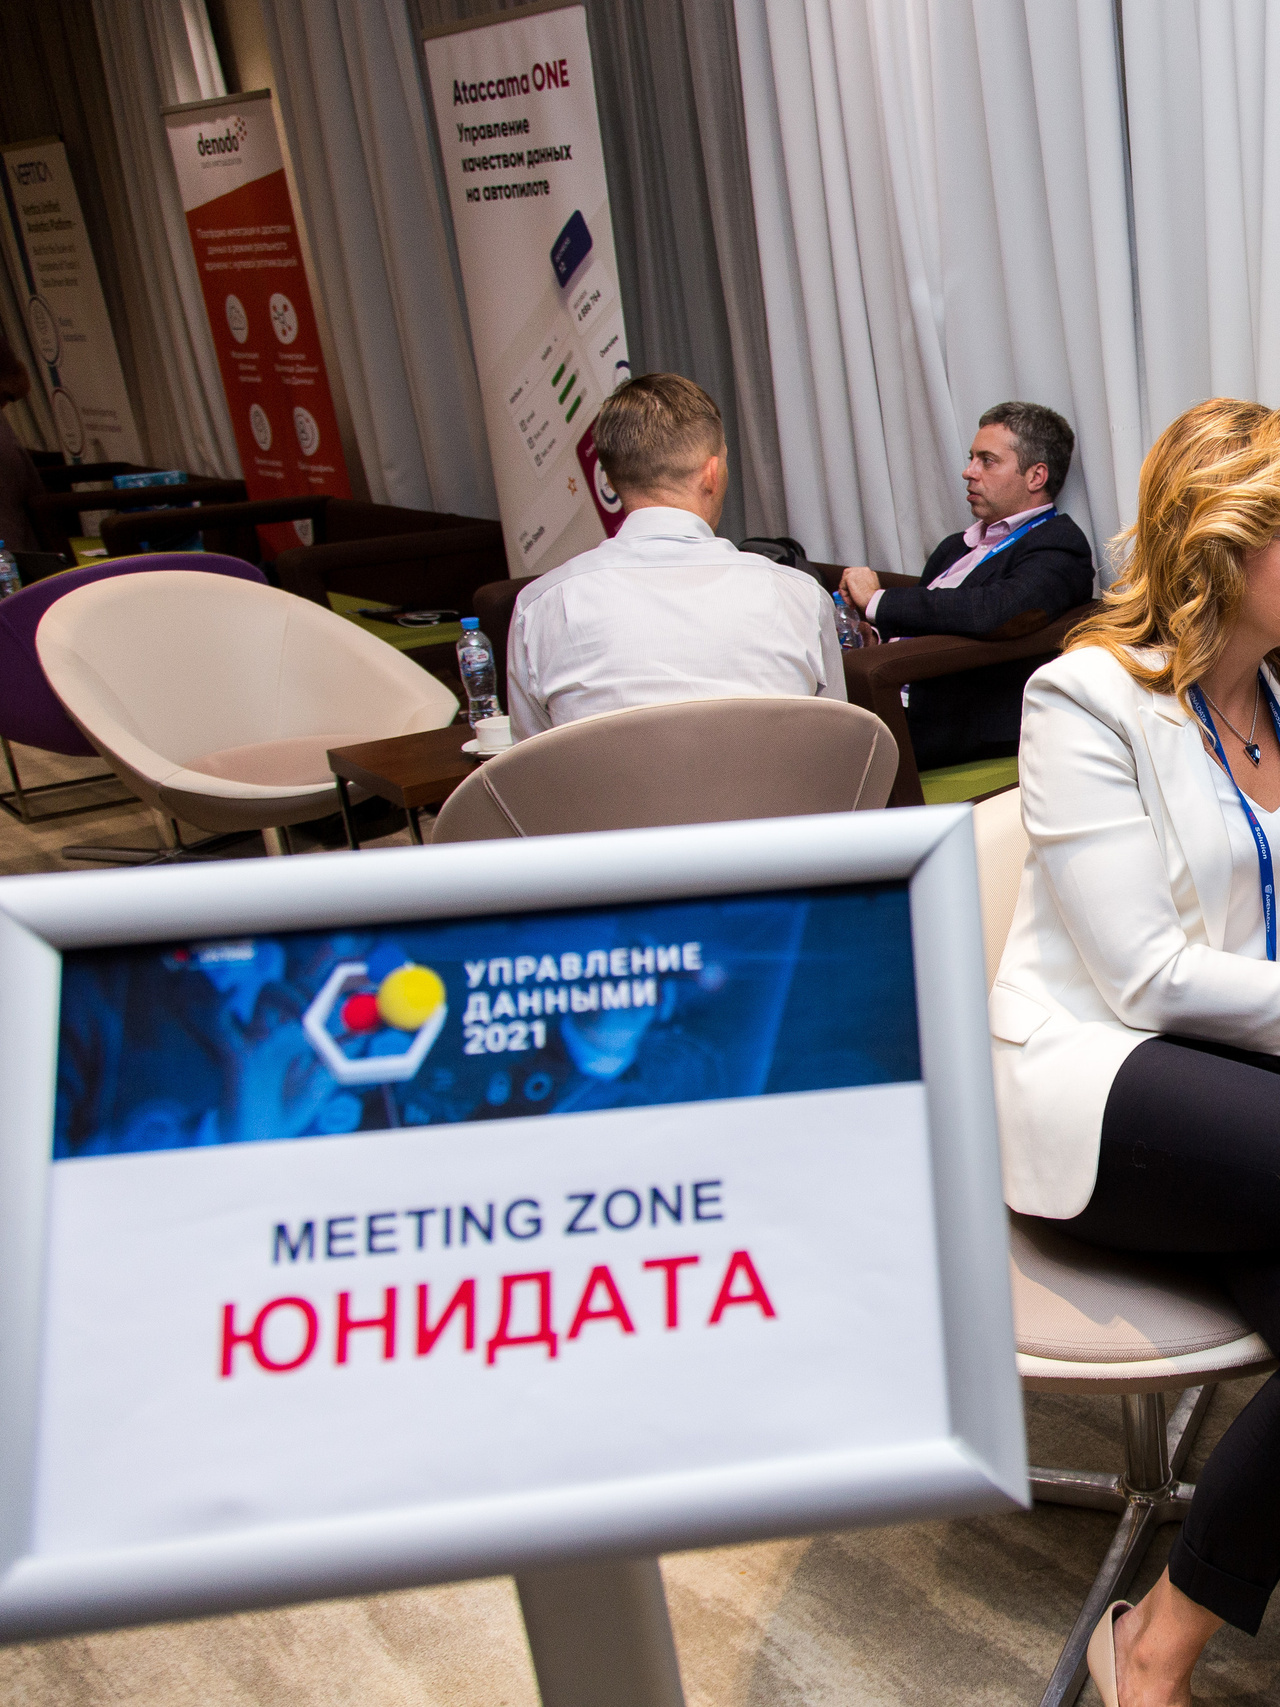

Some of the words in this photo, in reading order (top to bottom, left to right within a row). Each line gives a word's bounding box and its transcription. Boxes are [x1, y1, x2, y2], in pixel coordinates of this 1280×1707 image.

[453, 74, 530, 106] Ataccama
[532, 58, 571, 91] ONE
[197, 128, 240, 156] denodo
[456, 118, 530, 146] Управление
[461, 152, 525, 173] качеством
[526, 144, 573, 169] данных
[465, 187, 481, 203] на
[482, 179, 550, 201] автопилоте
[1254, 826, 1268, 860] Solution
[463, 941, 703, 988] УПРАВЛЕНИЕ
[463, 978, 657, 1025] ДАННЫМИ
[463, 1019, 547, 1055] 2021
[272, 1199, 544, 1264] MEETING
[564, 1180, 725, 1235] ZONE
[218, 1248, 778, 1379] ЮНИДАТА
